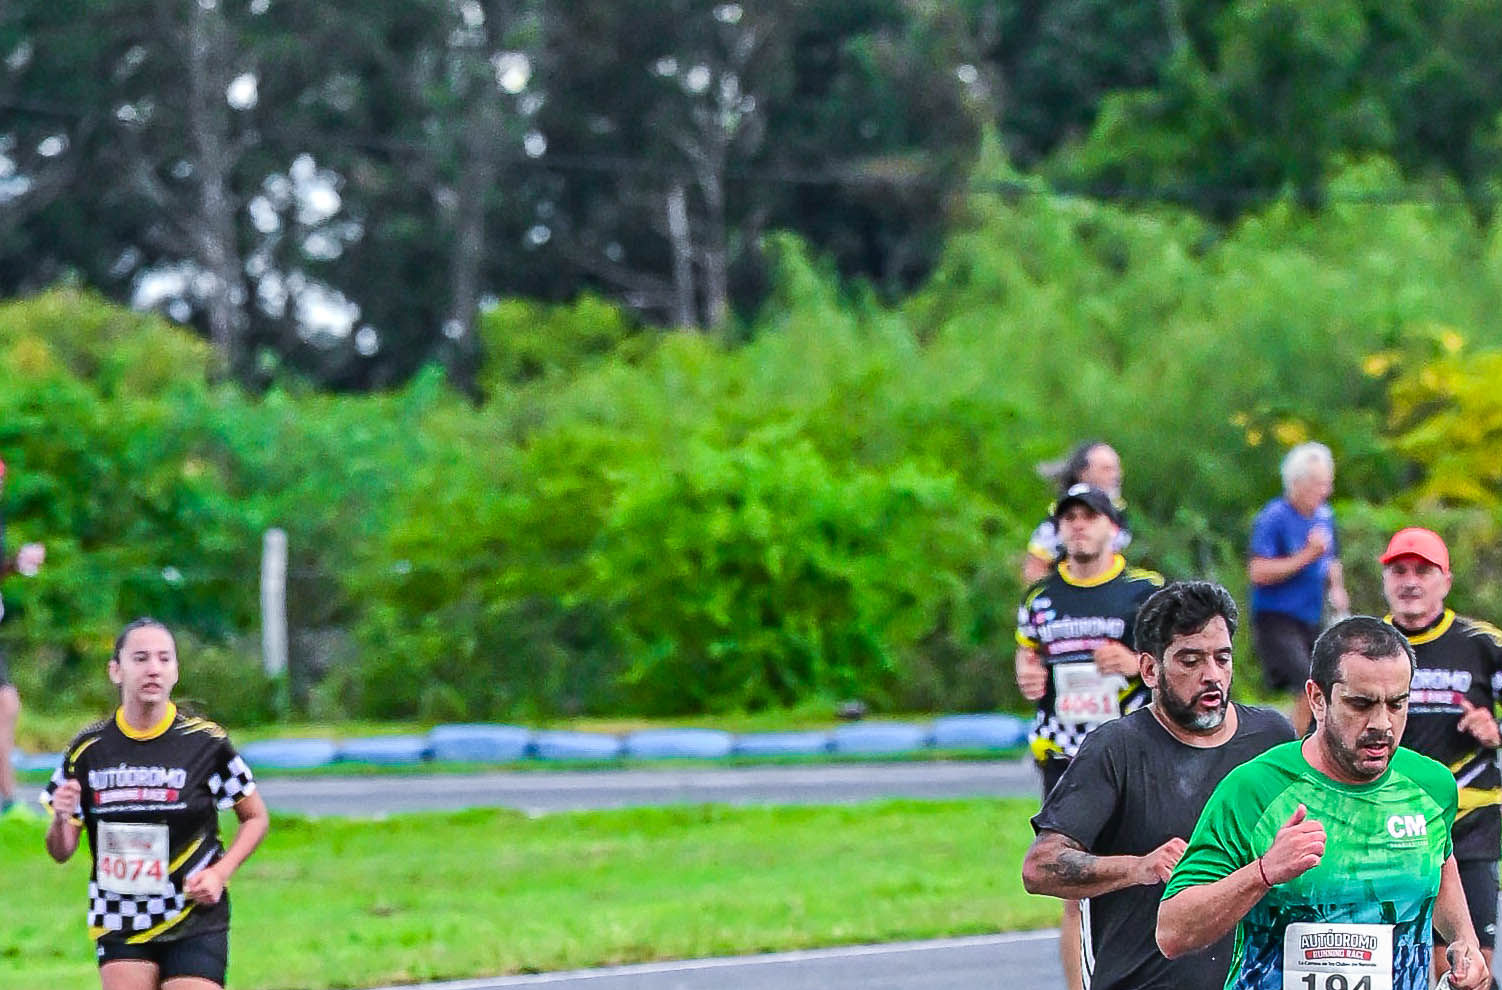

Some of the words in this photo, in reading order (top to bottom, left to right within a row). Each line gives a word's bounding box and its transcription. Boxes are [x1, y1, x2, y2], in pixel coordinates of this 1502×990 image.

[1387, 814, 1427, 839] CM
[101, 855, 164, 881] 4074
[1300, 928, 1378, 950] AUTÓDROMO
